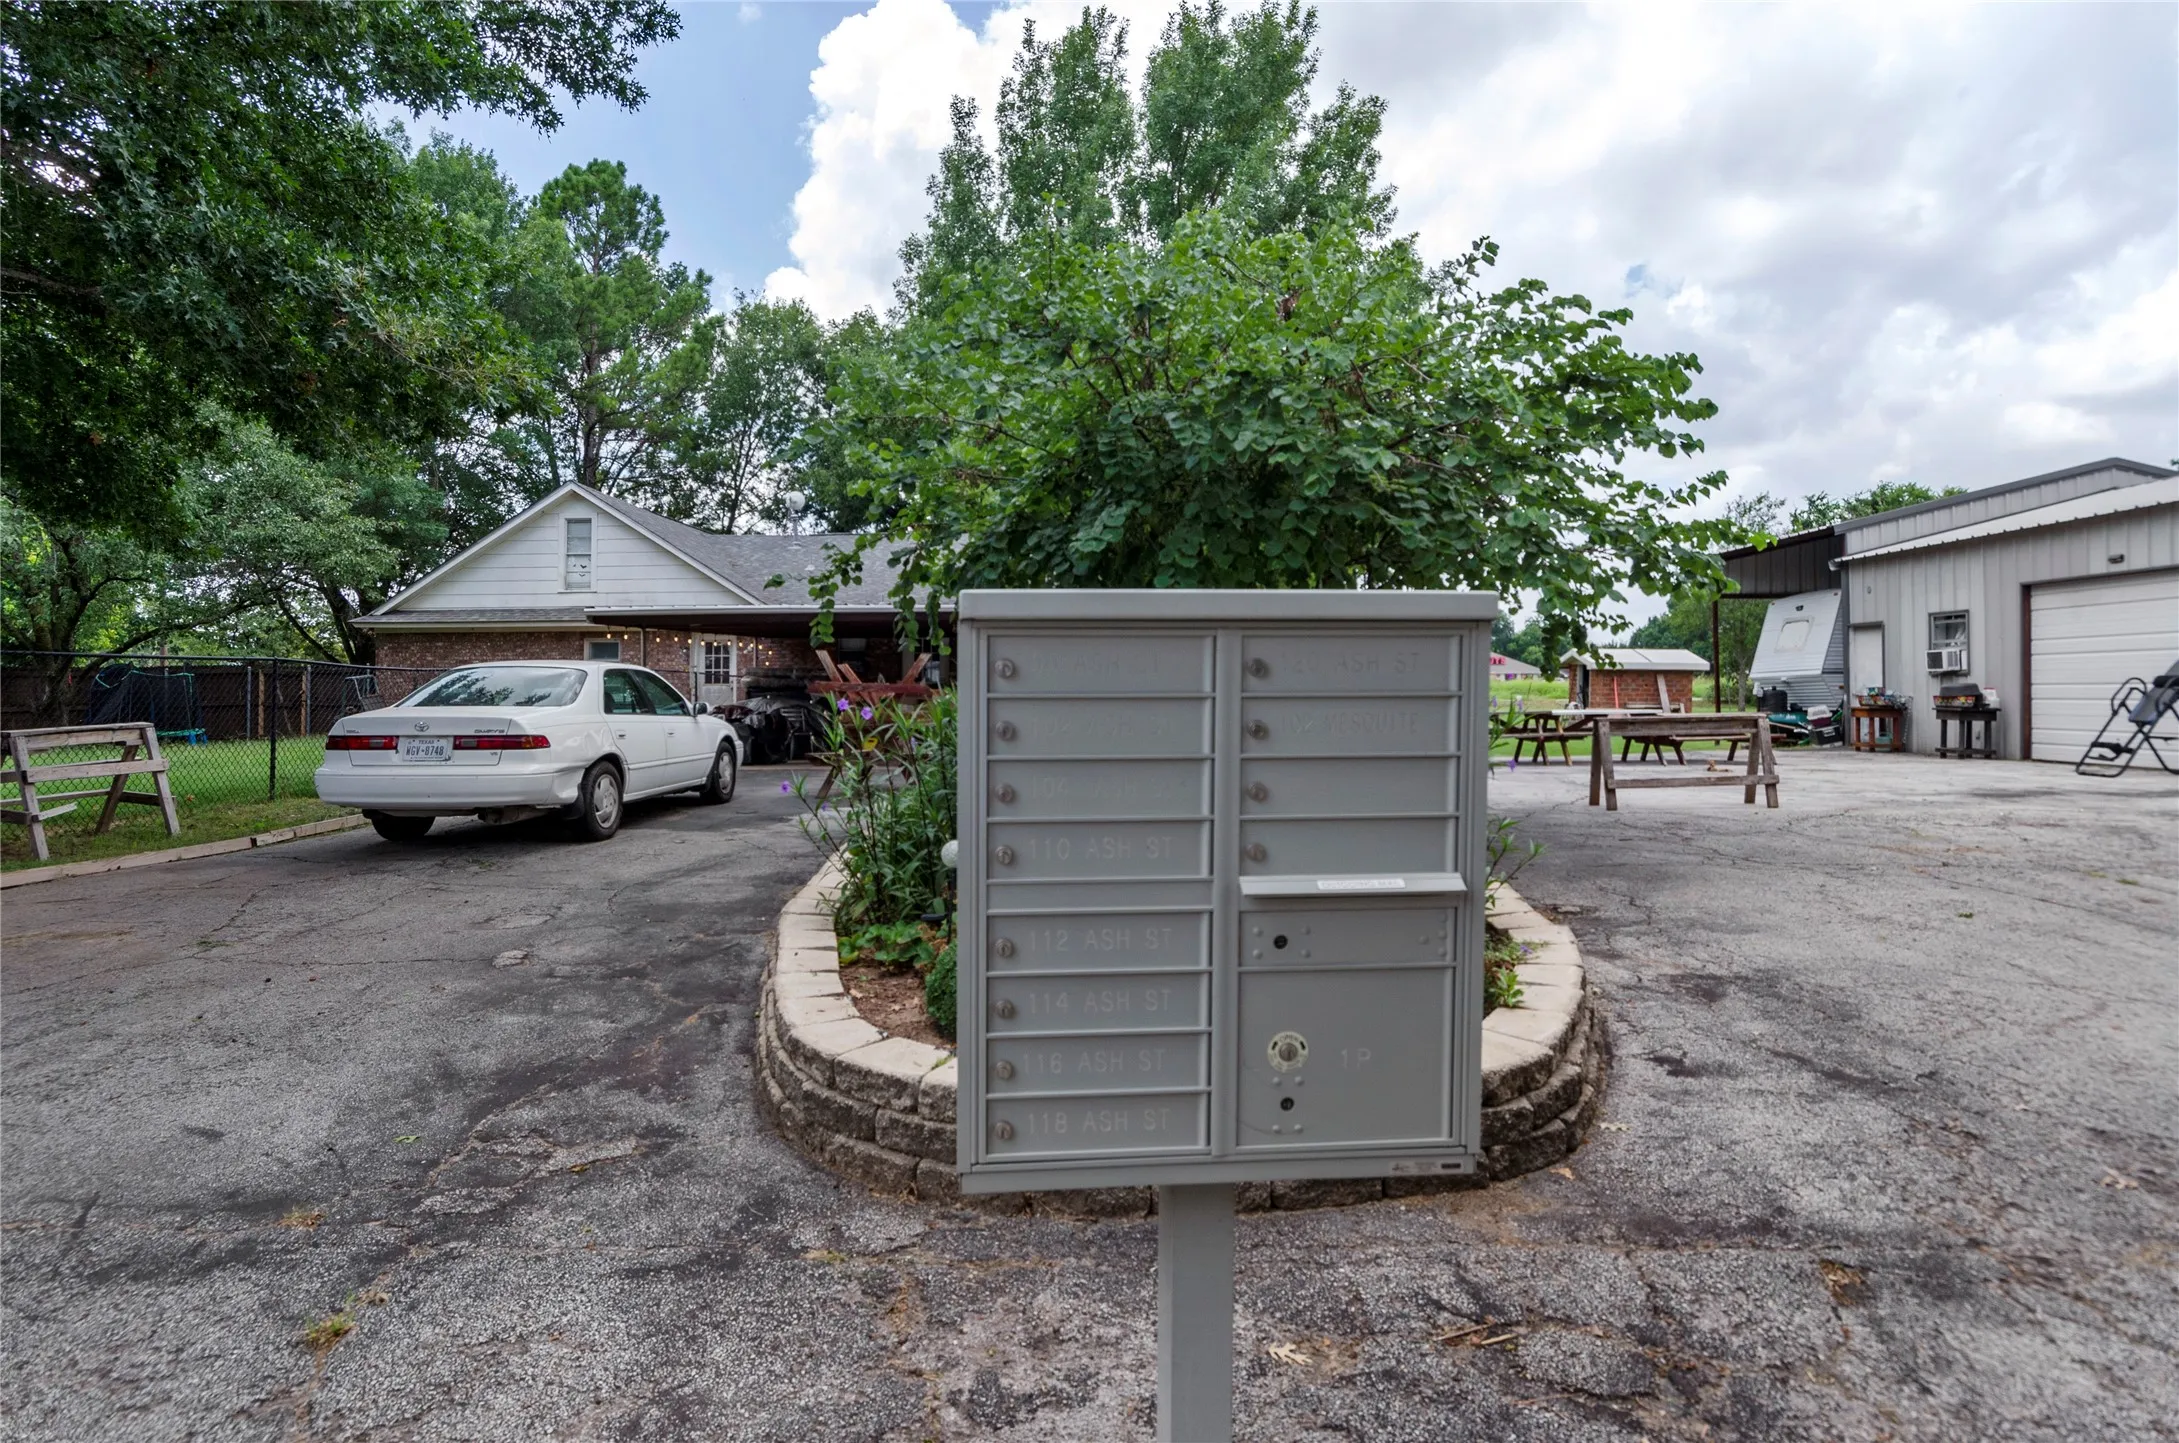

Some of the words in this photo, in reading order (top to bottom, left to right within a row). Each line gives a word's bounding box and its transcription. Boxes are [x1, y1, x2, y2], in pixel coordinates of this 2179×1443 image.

[1334, 652, 1381, 674] ASH
[1393, 651, 1421, 674] ST
[1028, 837, 1071, 861] 110
[1085, 836, 1132, 860] ASH
[1146, 835, 1173, 859] ST
[1029, 929, 1069, 952] 112
[1083, 928, 1130, 951] ASH
[1145, 927, 1173, 950] ST
[1029, 992, 1069, 1014] 114
[1083, 990, 1130, 1013] ASH
[1145, 989, 1173, 1012] ST
[1023, 1053, 1063, 1075] 116
[1077, 1051, 1124, 1074] ASH
[1138, 1049, 1167, 1072] ST
[1340, 1047, 1373, 1070] 1P
[1028, 1112, 1068, 1134] 118
[1082, 1110, 1129, 1132] ASH
[1142, 1109, 1171, 1131] ST
